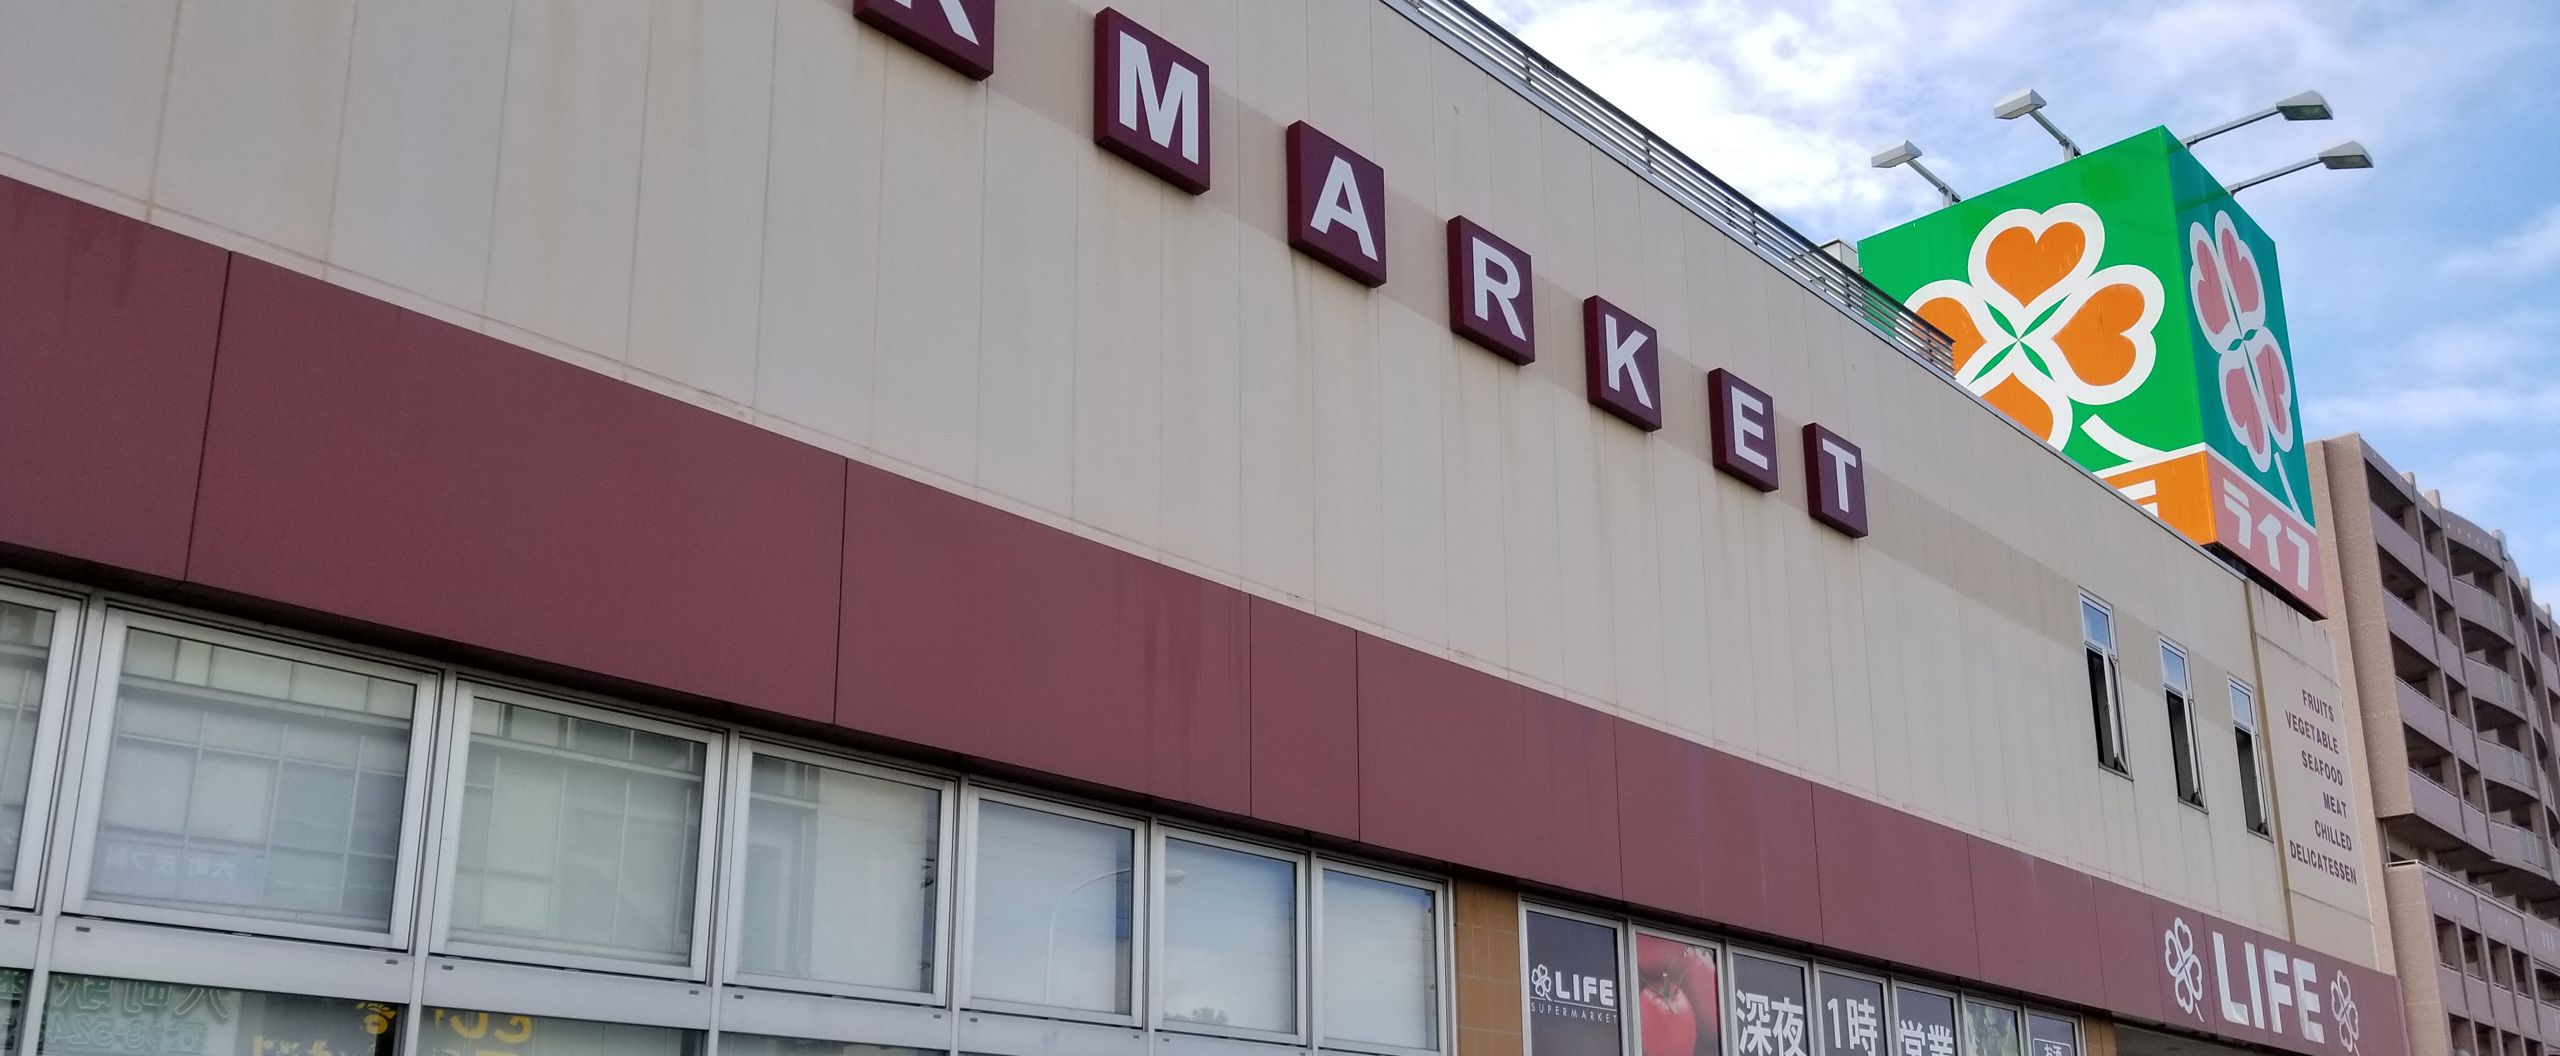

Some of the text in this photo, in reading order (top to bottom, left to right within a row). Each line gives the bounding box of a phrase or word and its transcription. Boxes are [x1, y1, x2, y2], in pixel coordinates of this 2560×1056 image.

[1119, 30, 1857, 514] MARKET
[2223, 478, 2310, 592] ライフ
[2302, 688, 2335, 723] FRUITS
[2285, 710, 2340, 755] VEGETABLE
[2301, 750, 2344, 787] SEAFOOD
[2323, 792, 2347, 819] MEAT
[2314, 819, 2353, 852] CHILLED
[2289, 840, 2358, 885] DELICATESSEN
[1554, 970, 1615, 1007] LIFE
[2212, 931, 2325, 1044] LIFE
[1530, 1001, 1618, 1024] SUPERMARKET
[1736, 989, 1806, 1056] 深夜
[1826, 997, 1878, 1056] 1時
